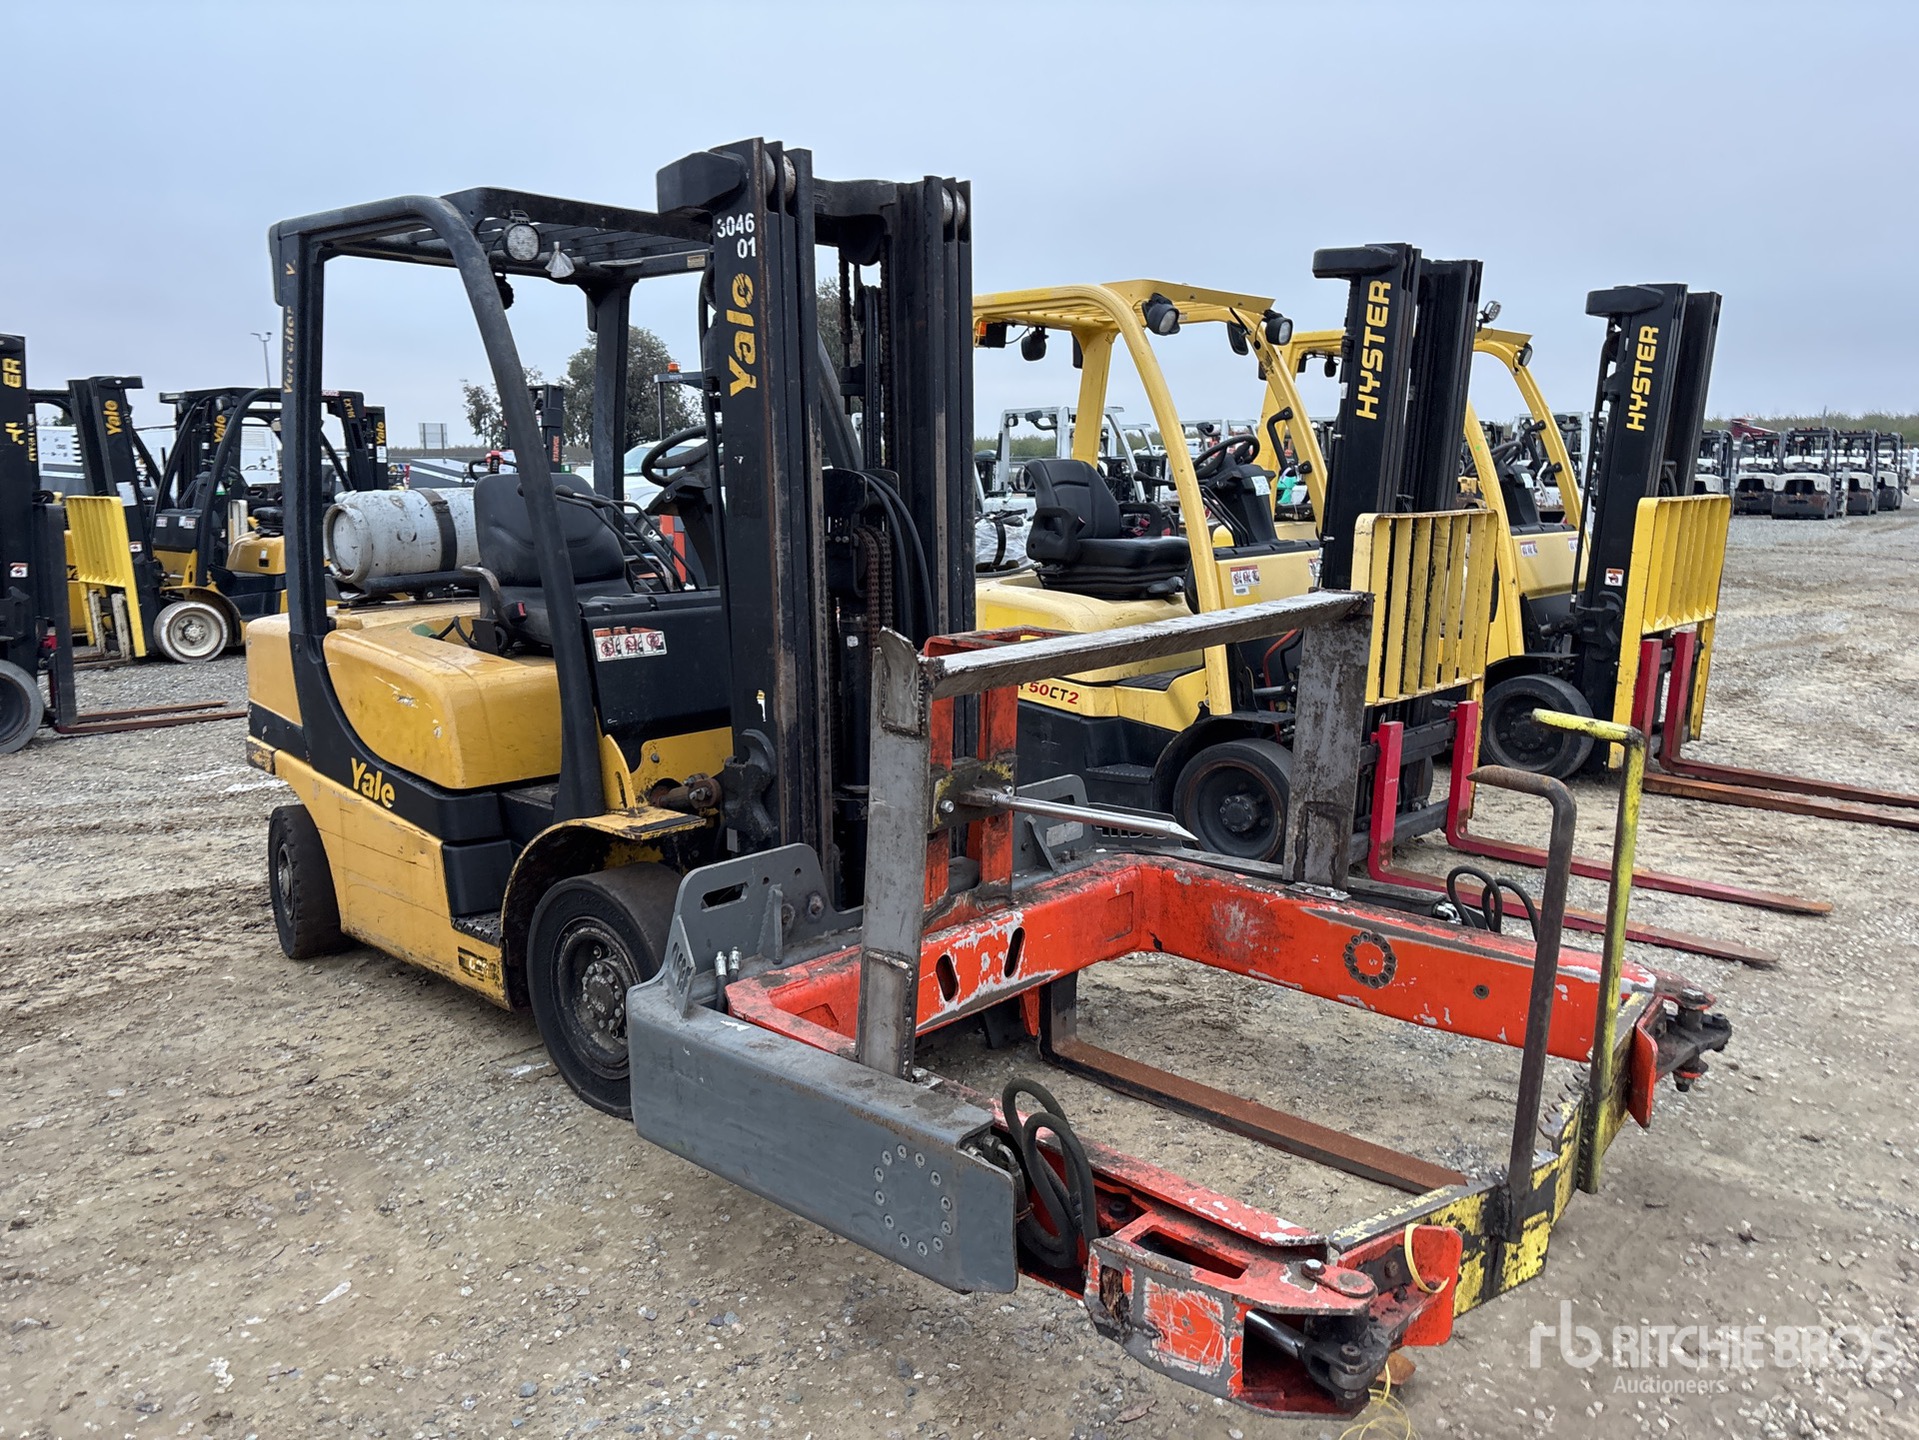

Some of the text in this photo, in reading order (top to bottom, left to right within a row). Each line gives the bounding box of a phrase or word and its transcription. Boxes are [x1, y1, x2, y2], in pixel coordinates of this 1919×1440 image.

[717, 213, 755, 238] 3046
[737, 237, 757, 259] 01
[726, 272, 757, 397] Yale
[1356, 280, 1392, 420] HYSTER
[1626, 325, 1659, 431] HYSTER
[103, 400, 123, 435] Yale
[214, 414, 227, 443] Yale
[376, 421, 385, 444] Yale
[1029, 682, 1079, 704] 50CT2
[350, 757, 396, 809] Yale
